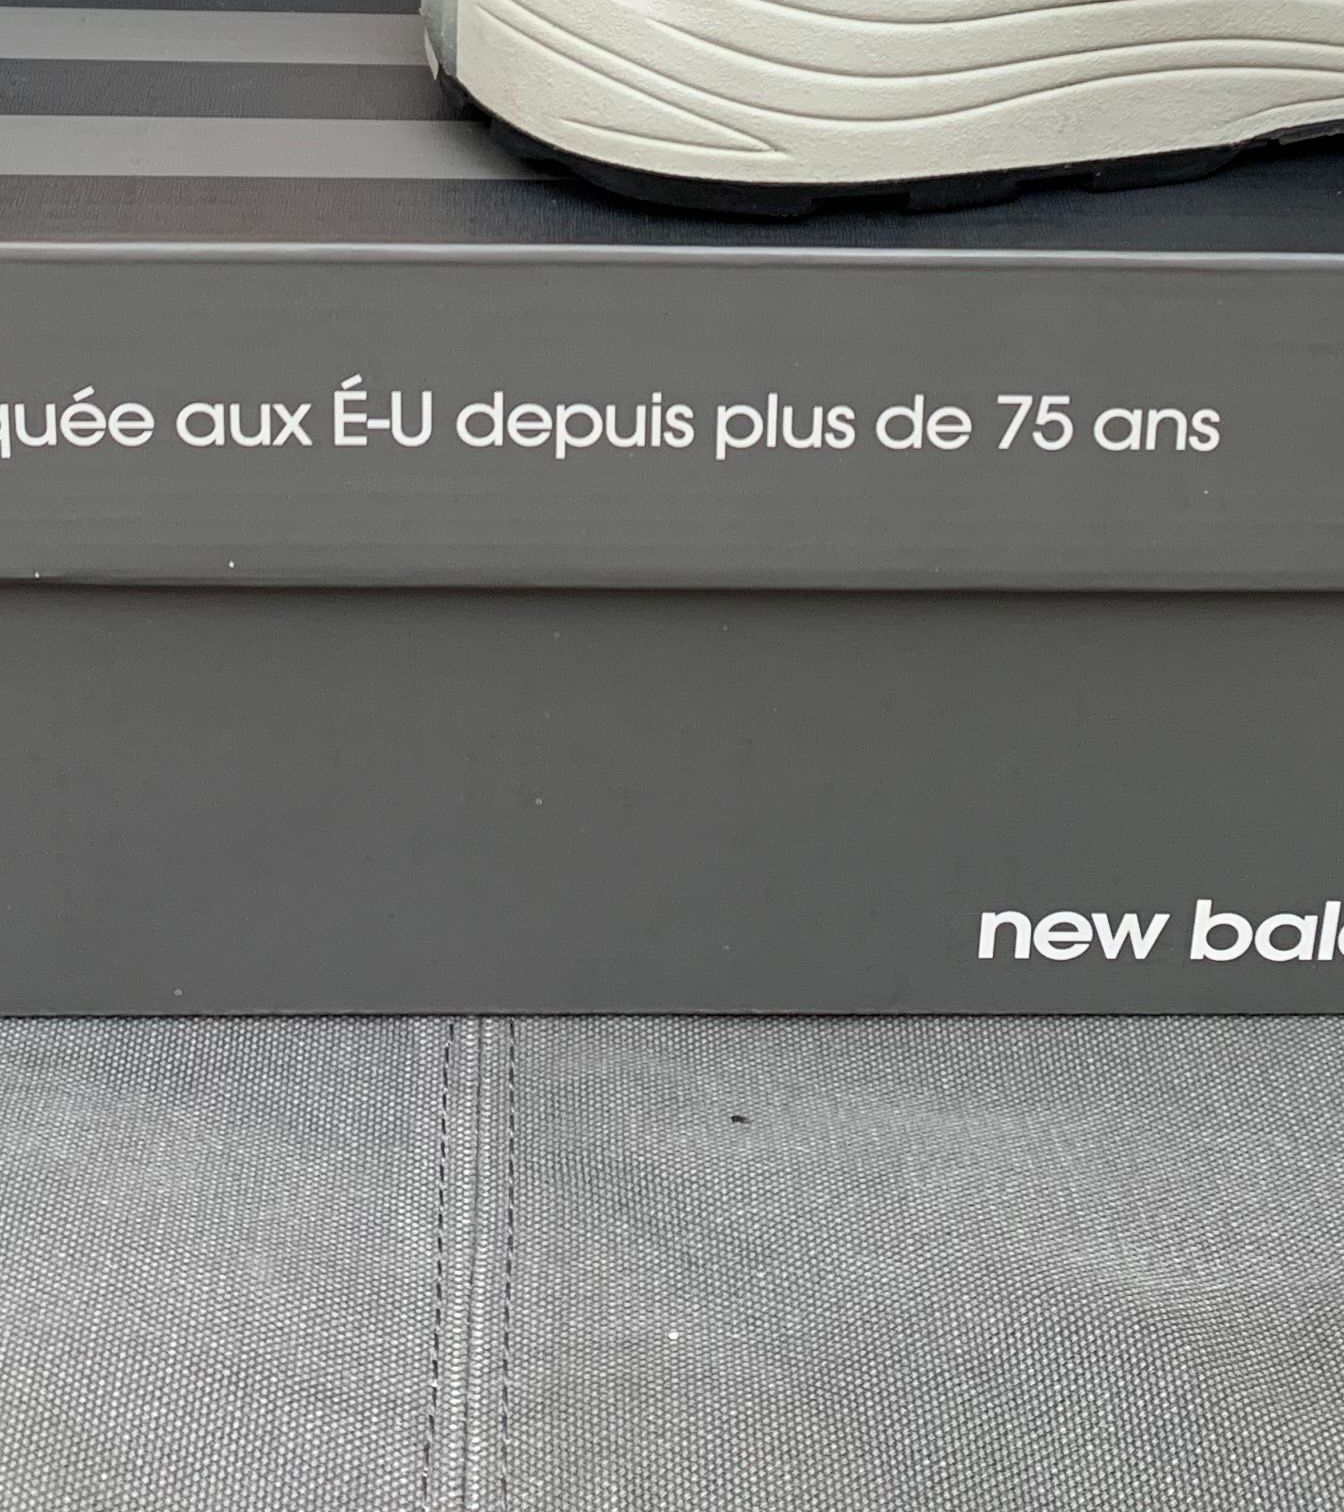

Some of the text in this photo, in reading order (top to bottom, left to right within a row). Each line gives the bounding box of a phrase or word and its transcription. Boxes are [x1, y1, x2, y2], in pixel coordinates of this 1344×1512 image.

[175, 401, 314, 448] aux
[332, 373, 433, 448] É-U
[455, 390, 696, 461] depuis
[714, 392, 857, 461] plus
[875, 393, 973, 451] de
[996, 394, 1075, 452] 75
[1092, 407, 1221, 453] ans
[977, 908, 1172, 962] new
